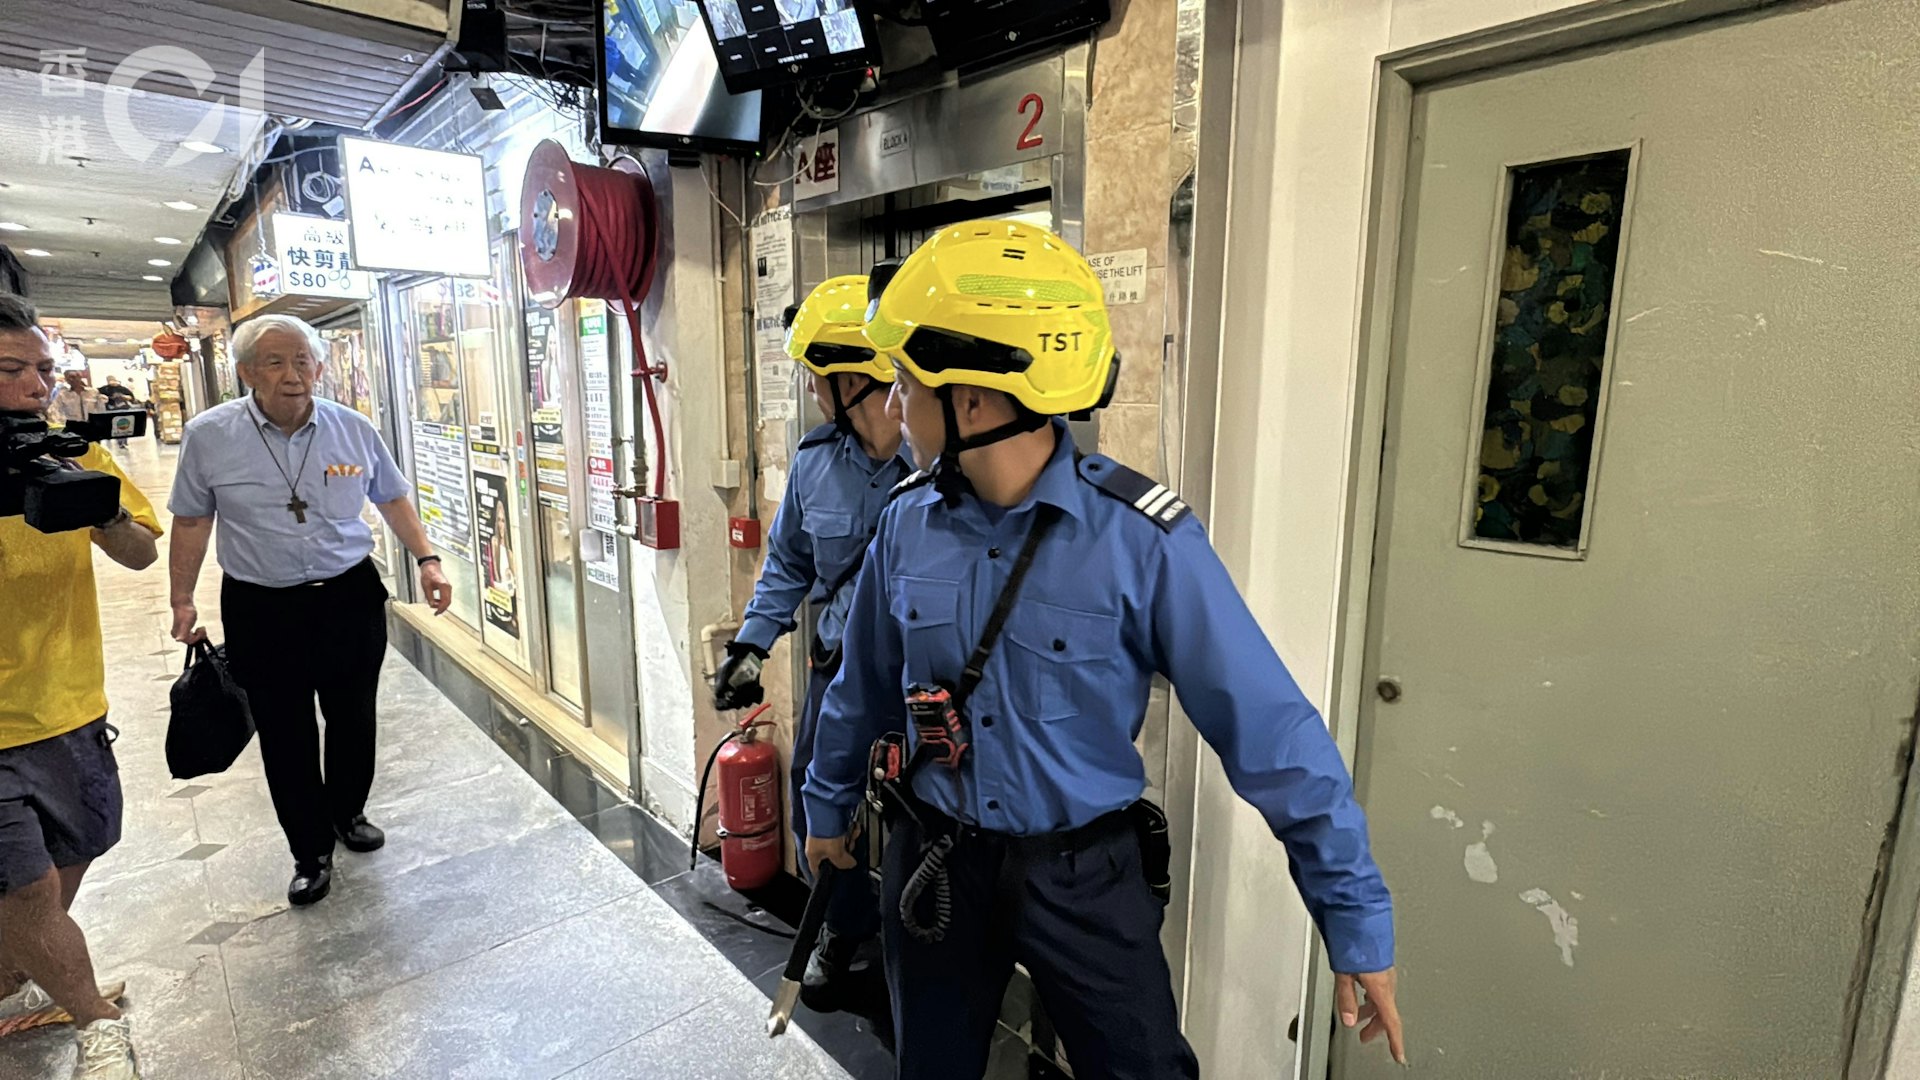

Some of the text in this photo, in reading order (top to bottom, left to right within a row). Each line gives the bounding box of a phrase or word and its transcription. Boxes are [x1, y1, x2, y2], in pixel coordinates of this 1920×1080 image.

[1016, 93, 1044, 150] 2
[1088, 256, 1115, 267] ASE OF
[1109, 266, 1125, 278] THE
[1126, 264, 1143, 277] LIFT
[1037, 331, 1082, 352] TST
